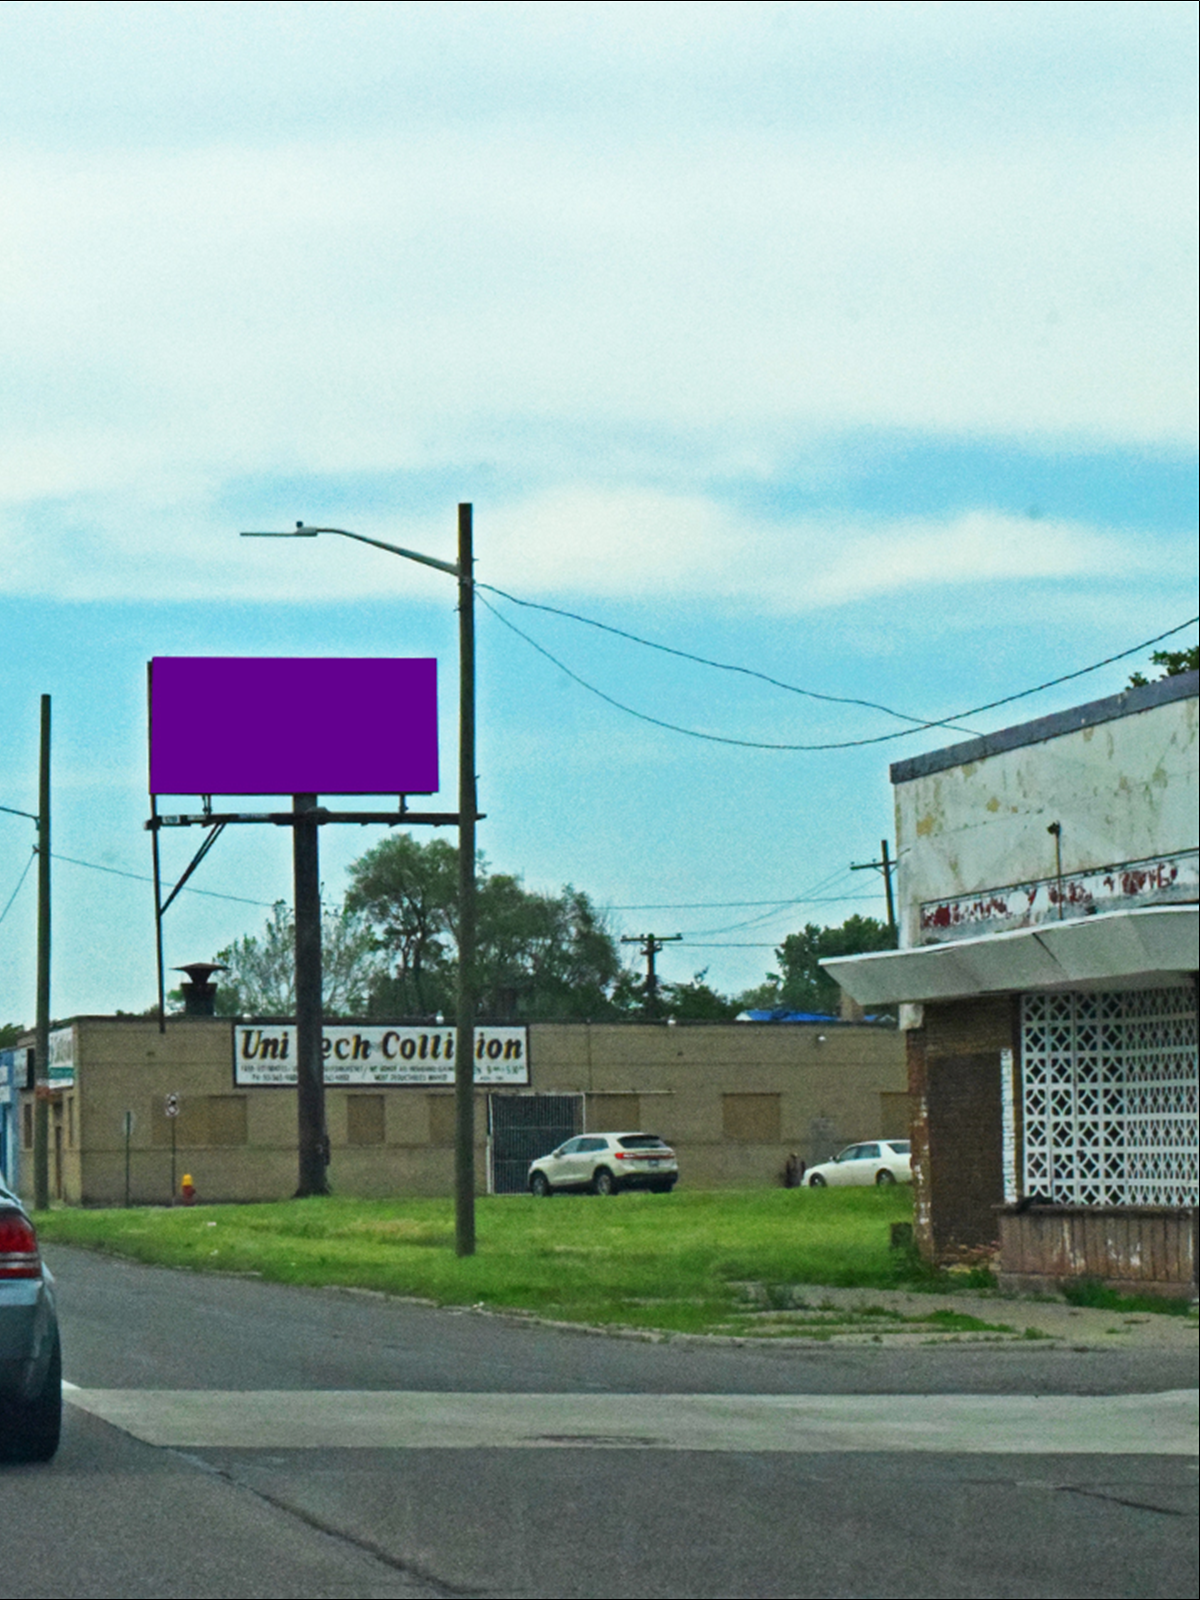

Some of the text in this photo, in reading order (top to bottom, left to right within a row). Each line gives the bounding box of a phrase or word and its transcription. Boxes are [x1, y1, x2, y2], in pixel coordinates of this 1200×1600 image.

[241, 1029, 523, 1061] Uni ech Colliion
